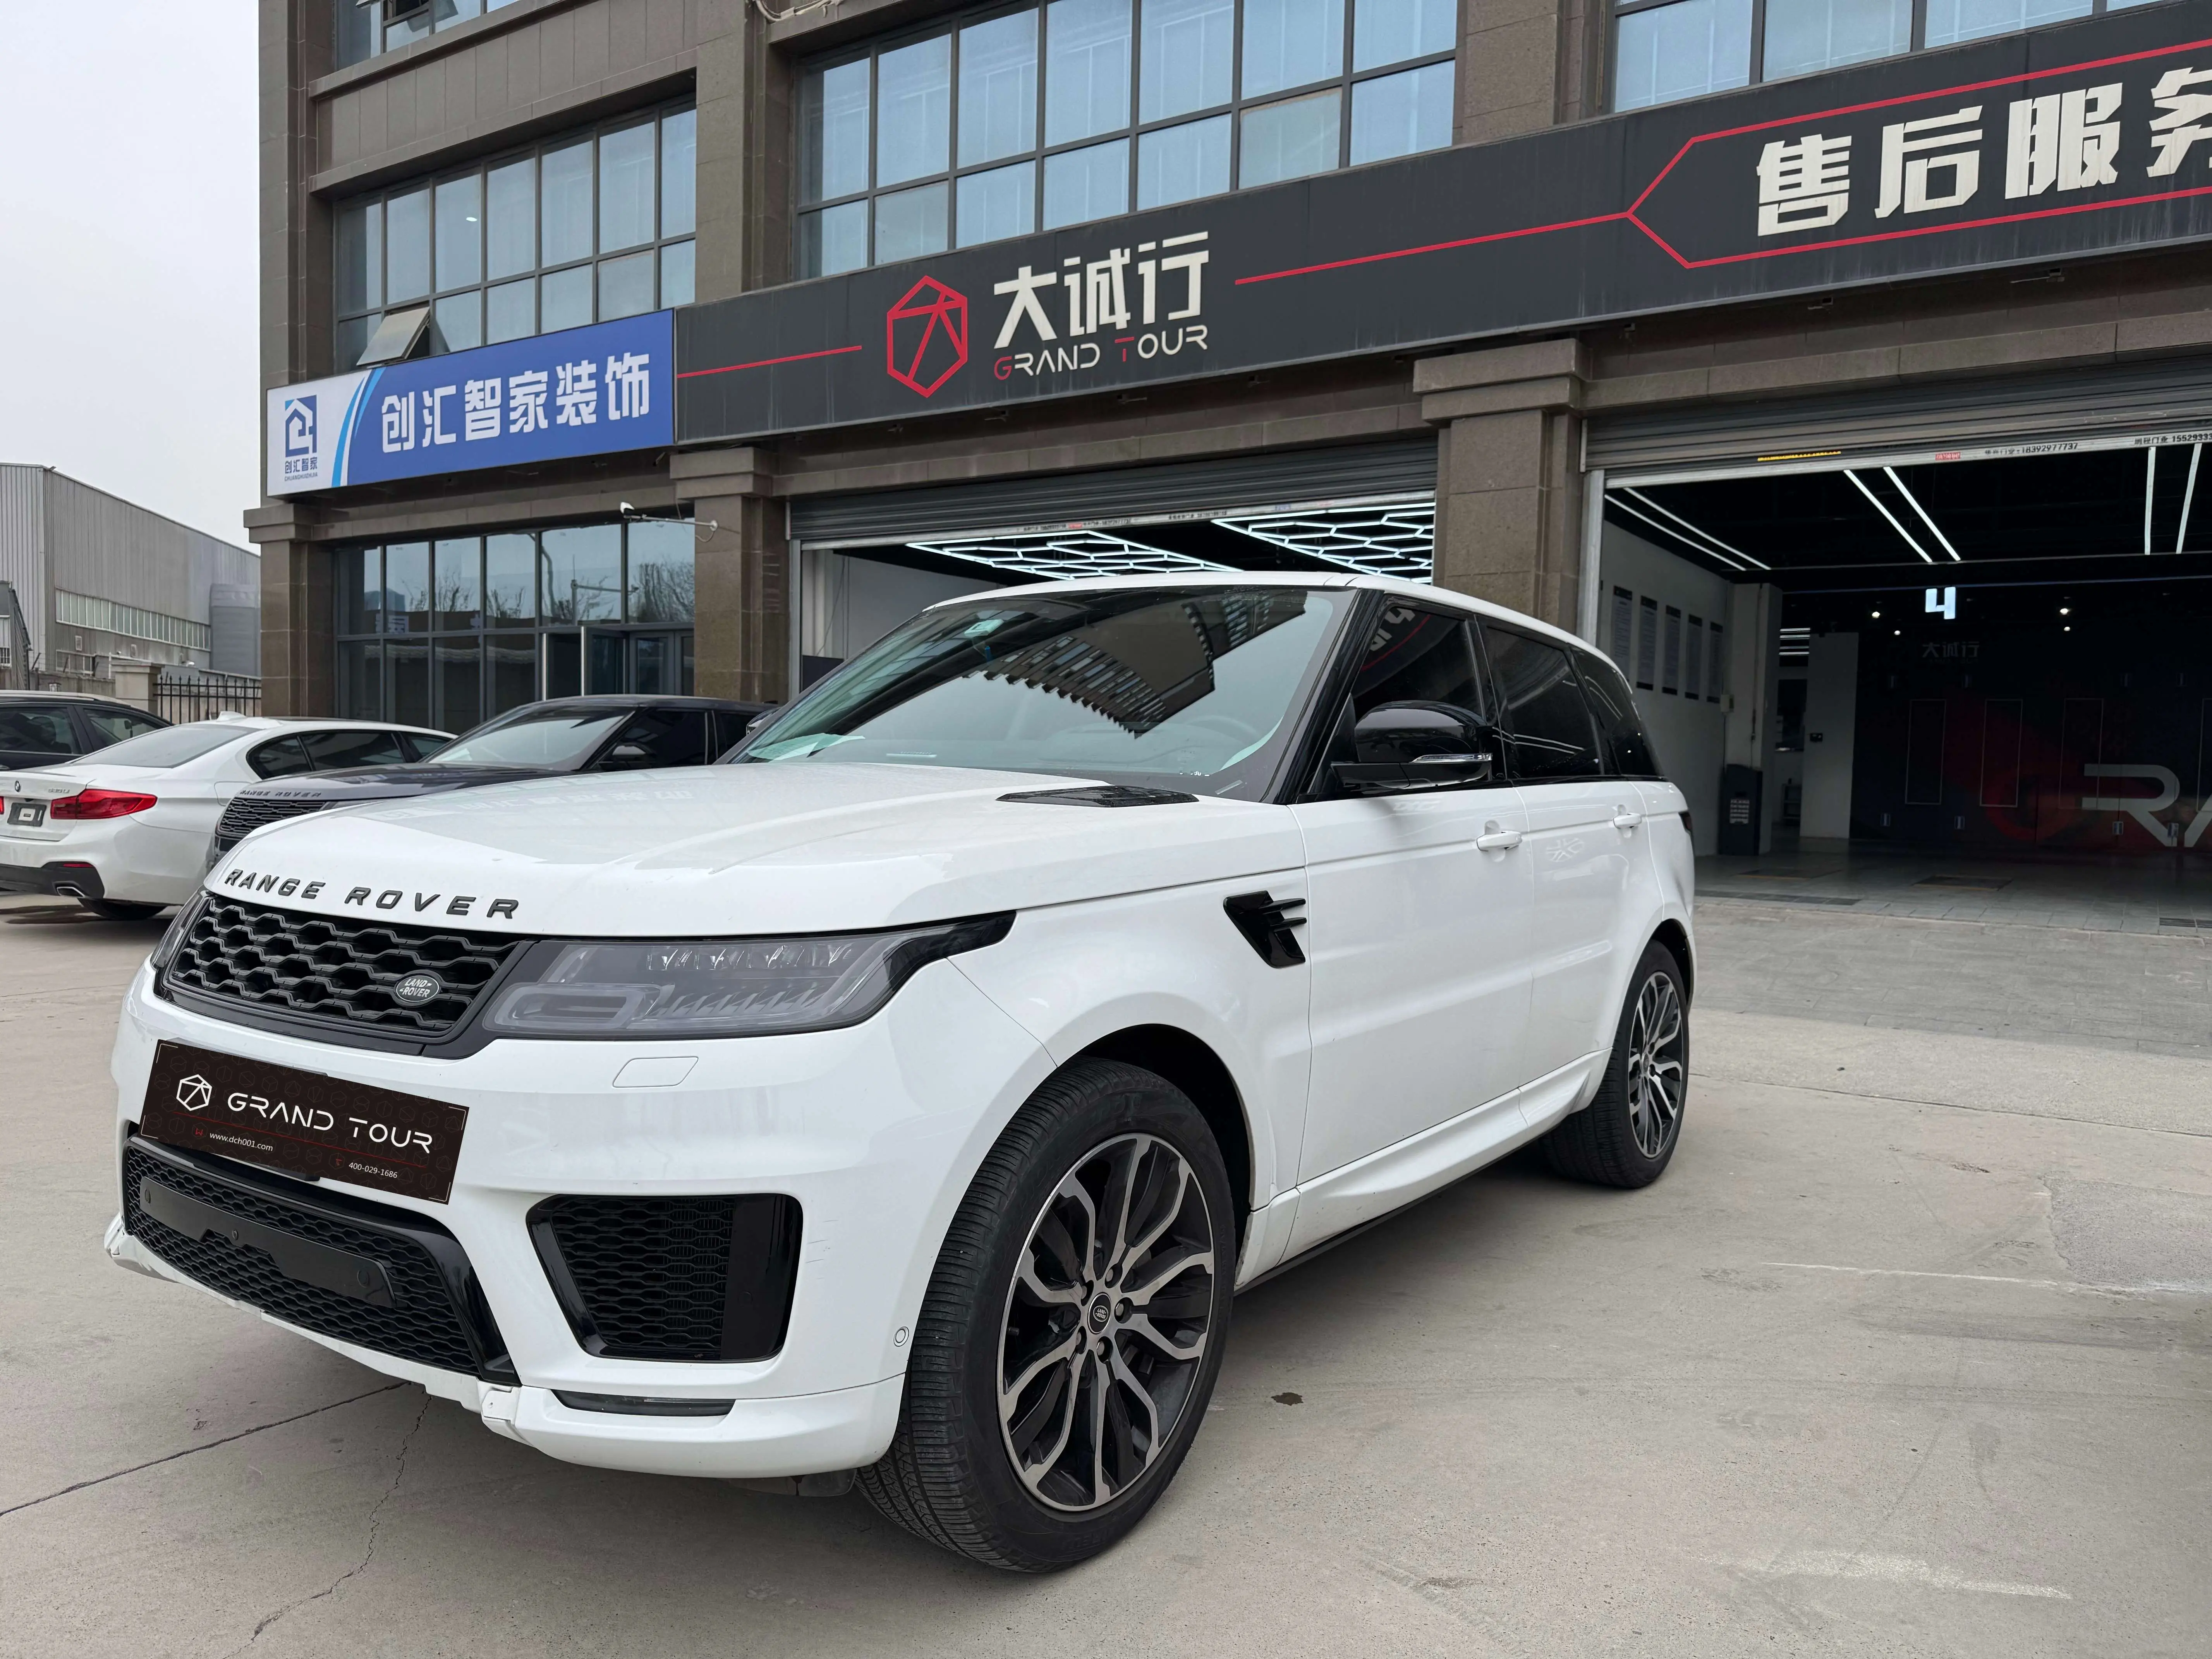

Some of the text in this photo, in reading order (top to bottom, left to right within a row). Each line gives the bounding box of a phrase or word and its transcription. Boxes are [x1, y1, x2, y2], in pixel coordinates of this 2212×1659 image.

[994, 231, 1209, 349] 大诚行
[994, 325, 1208, 380] GRAND TOUR
[381, 352, 650, 453] 创汇智家装饰
[285, 457, 318, 474] 创汇智家
[1925, 586, 1956, 620] 4
[225, 869, 519, 919] RANGE ROVER
